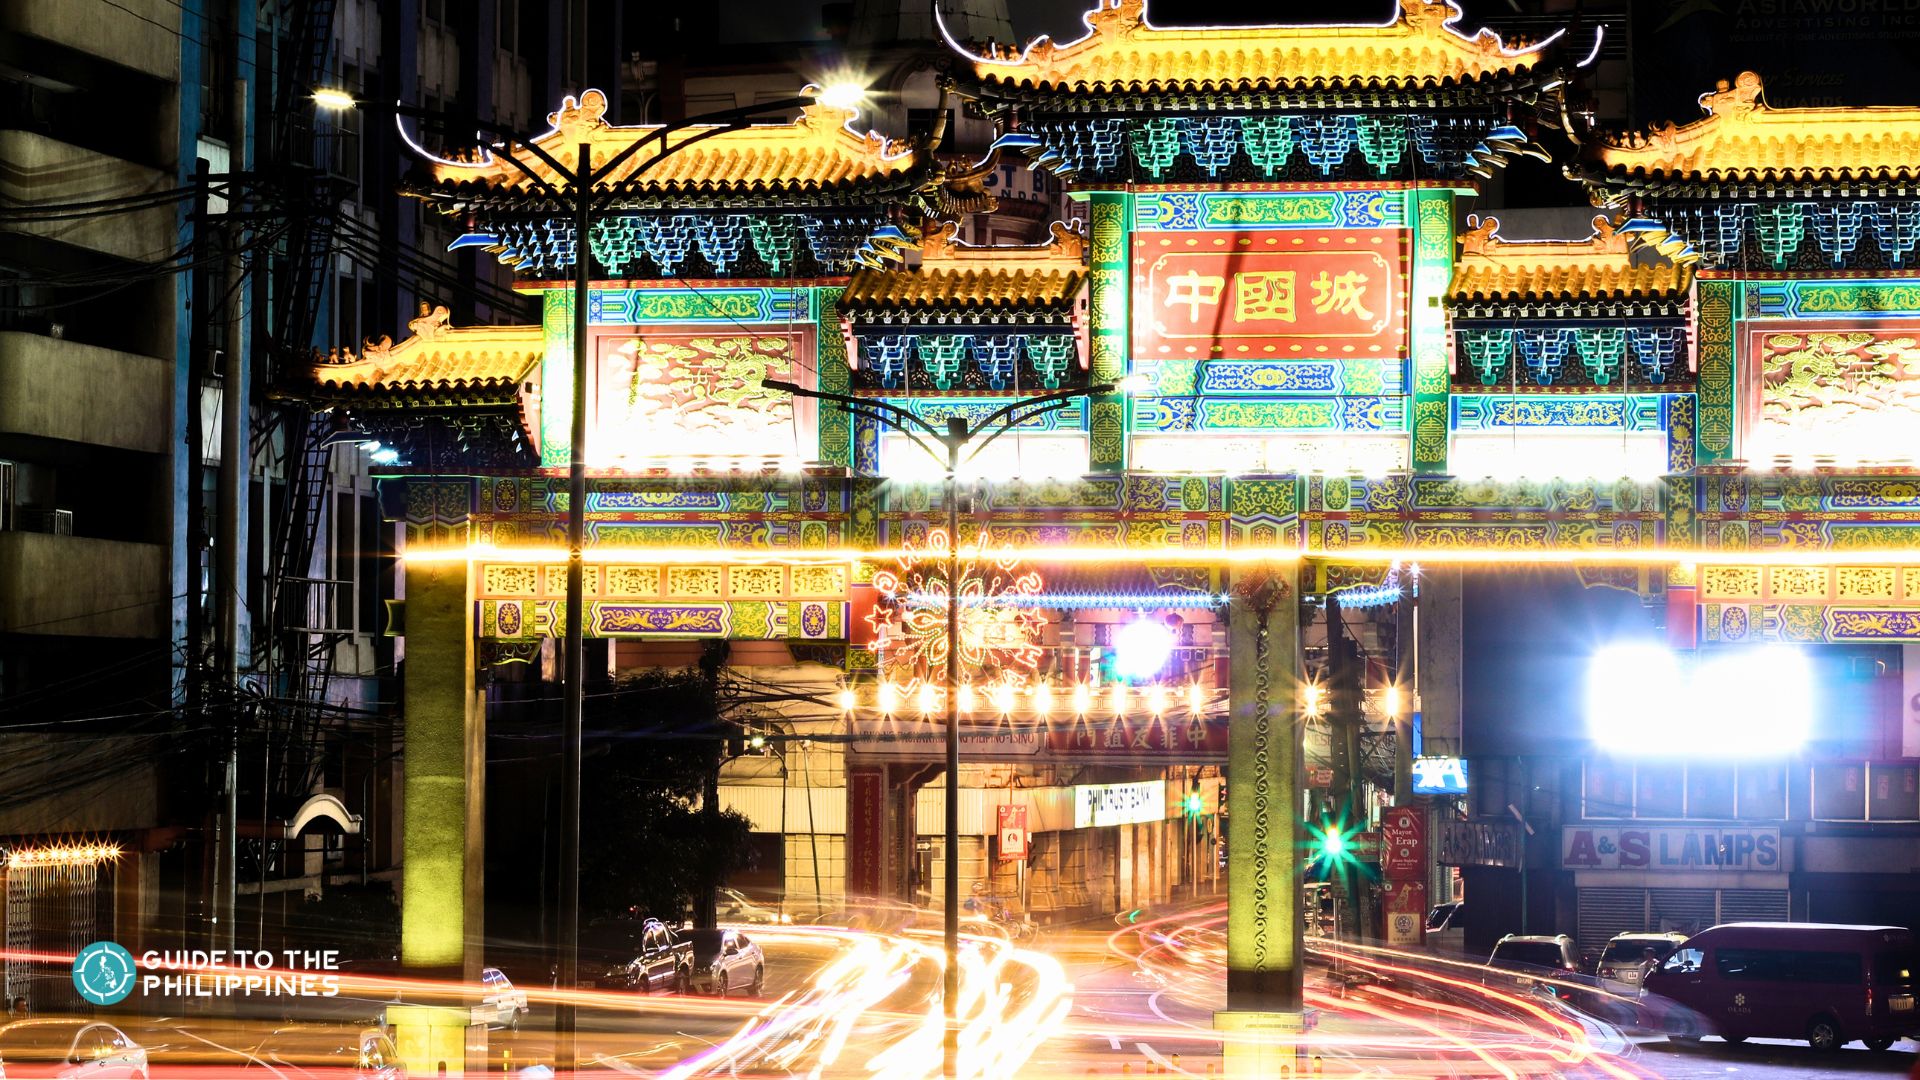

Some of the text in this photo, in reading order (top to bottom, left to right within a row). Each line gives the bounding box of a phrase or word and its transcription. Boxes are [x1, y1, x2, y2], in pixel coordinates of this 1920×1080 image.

[1088, 786, 1151, 811] PHILTRUST BANK
[1392, 829, 1412, 837] Mayor
[1396, 837, 1418, 847] Erap
[1563, 831, 1777, 866] A&S LAMPS
